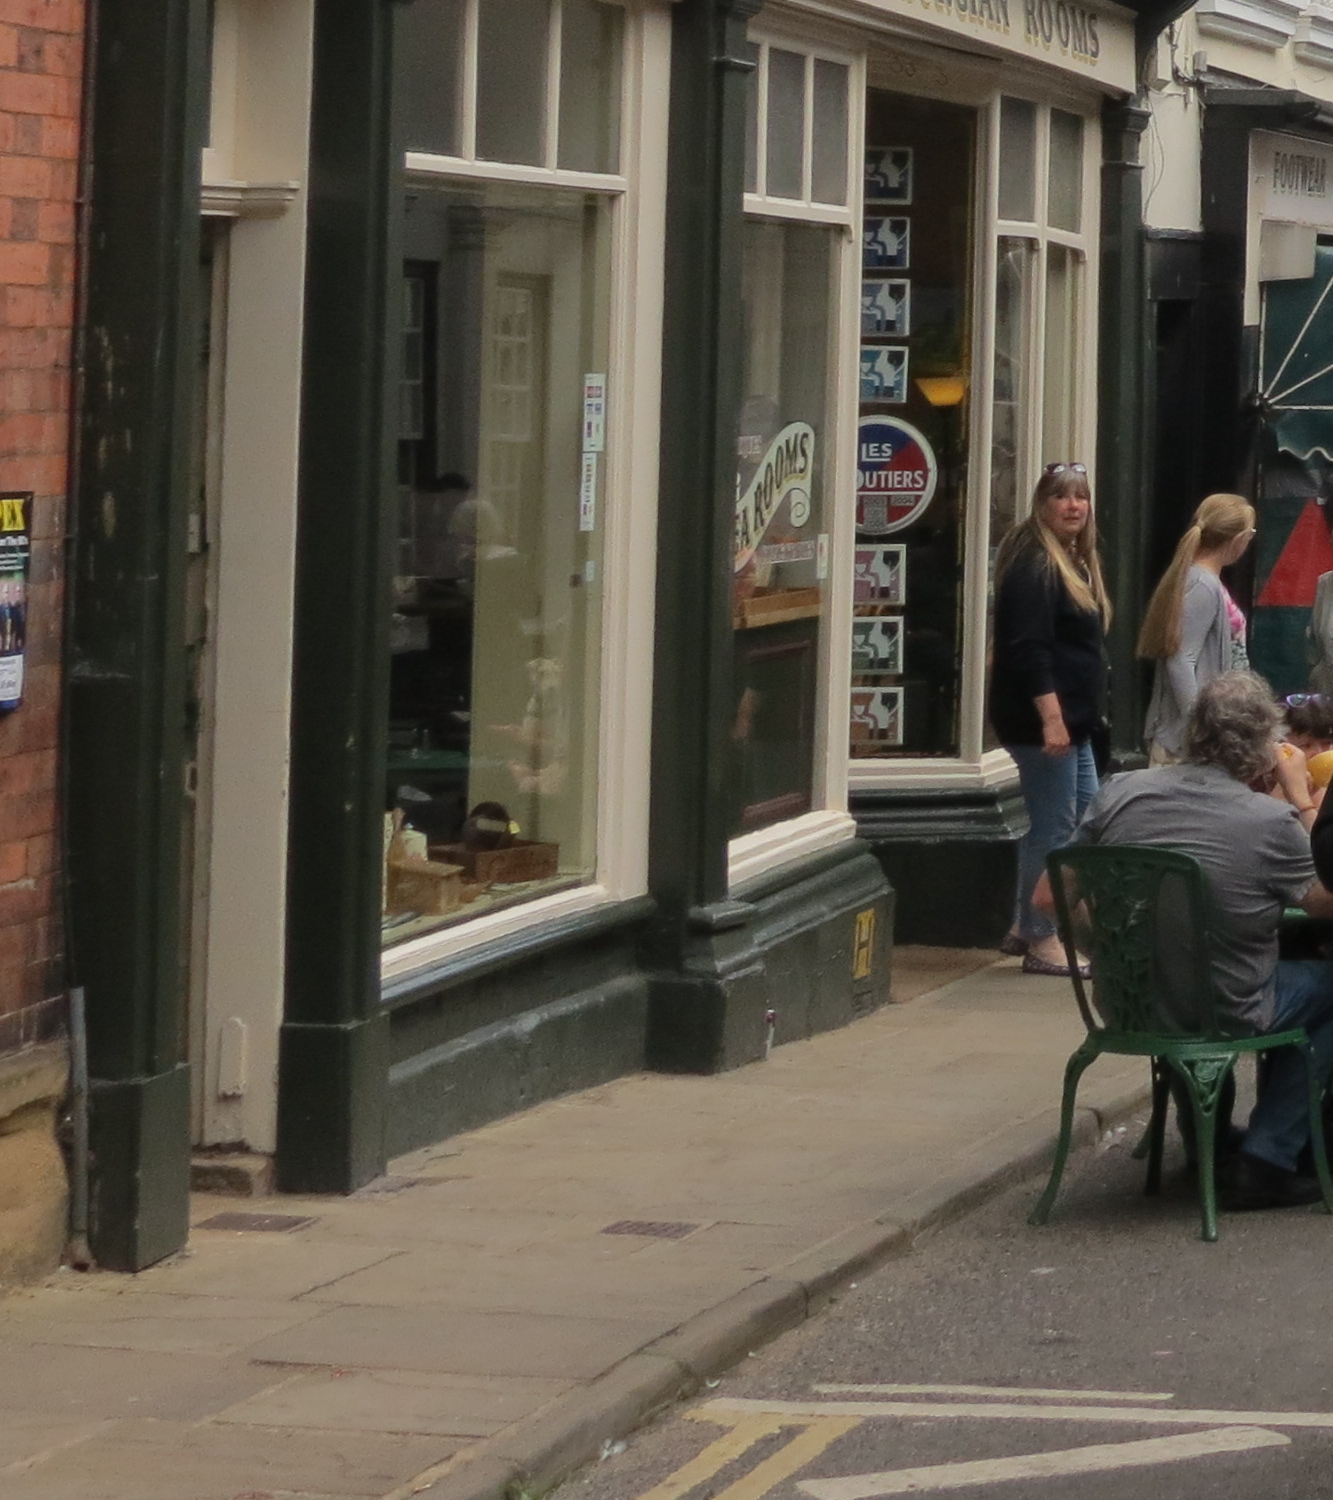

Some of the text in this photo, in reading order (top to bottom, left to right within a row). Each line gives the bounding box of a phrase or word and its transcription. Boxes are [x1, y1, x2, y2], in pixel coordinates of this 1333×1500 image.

[1273, 150, 1327, 198] FOOTWEAR
[861, 443, 893, 462] LES
[752, 431, 810, 534] ROOMS
